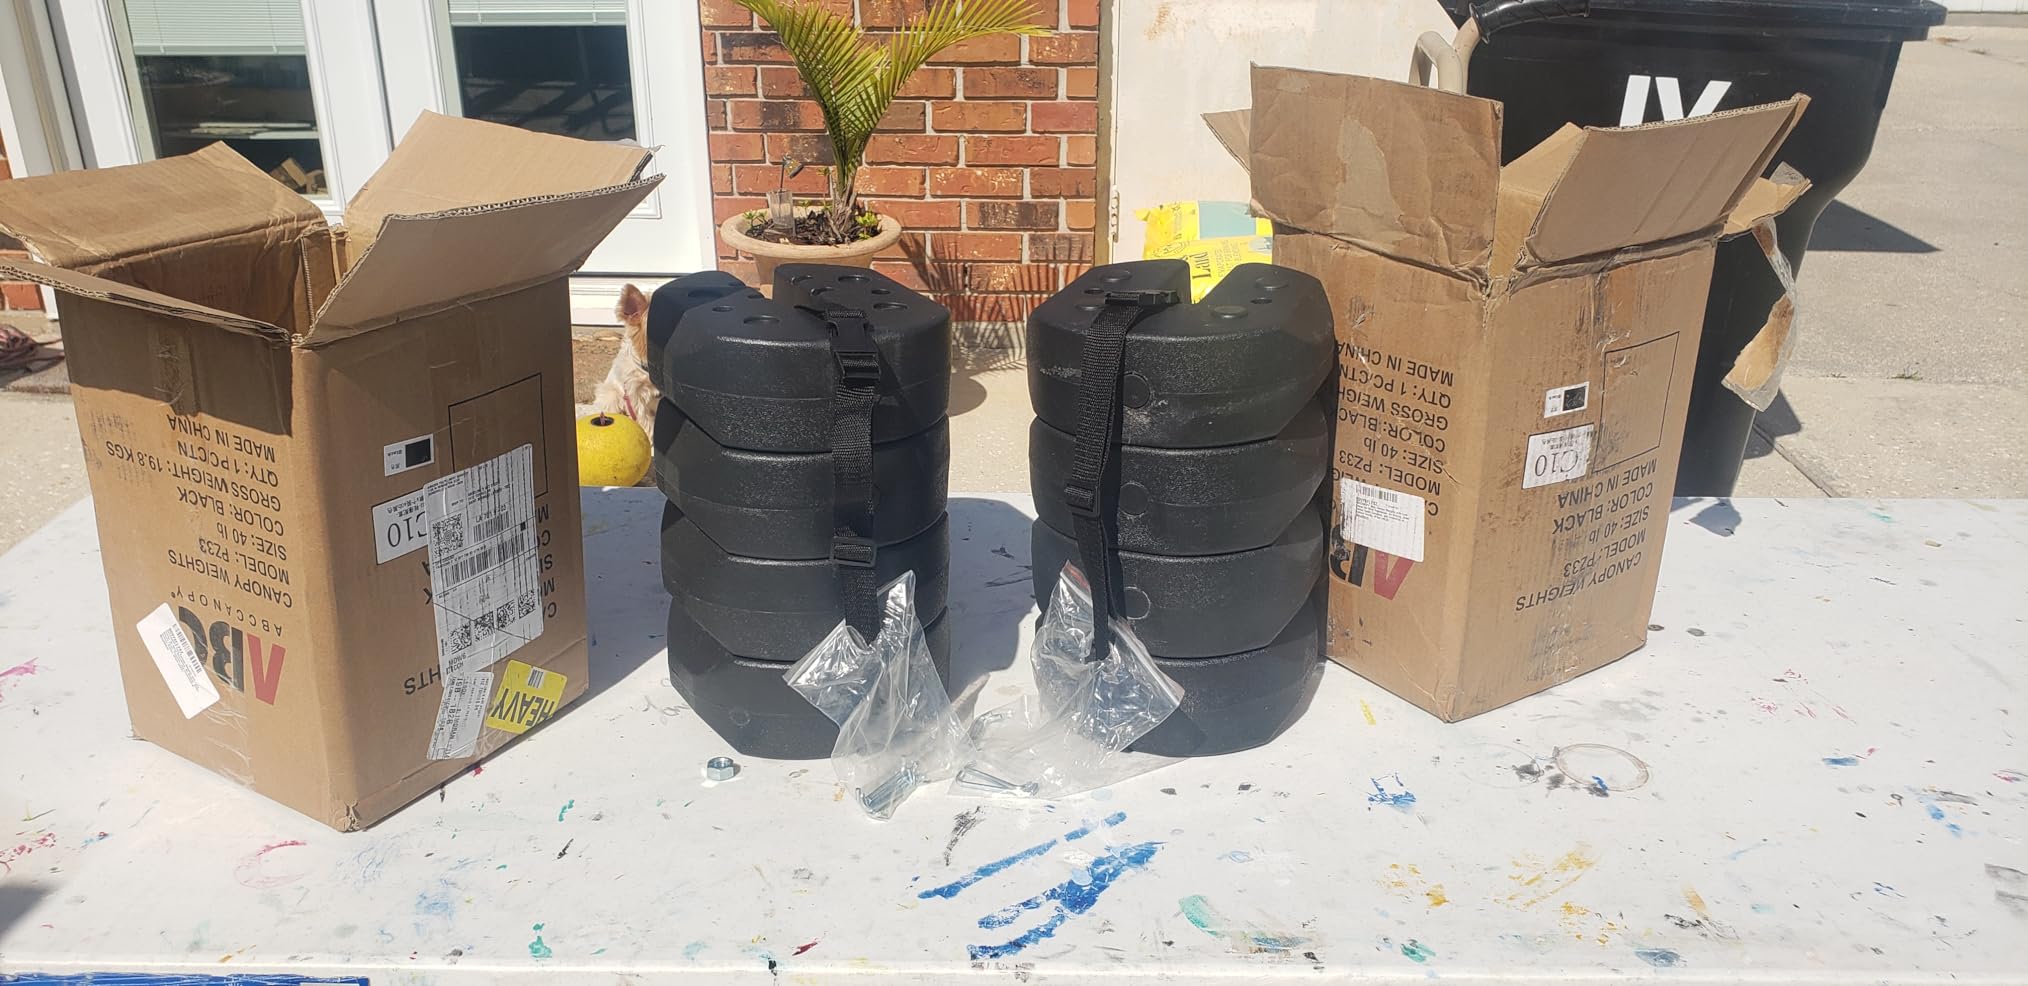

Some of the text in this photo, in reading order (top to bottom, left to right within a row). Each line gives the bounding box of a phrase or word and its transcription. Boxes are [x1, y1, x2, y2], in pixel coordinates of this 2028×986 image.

[1387, 355, 1401, 372] IN
[1406, 360, 1454, 387] MADE
[1400, 382, 1407, 396] 1
[1413, 385, 1451, 409] QTY:
[1338, 387, 1448, 431] GROSS WEIGH
[166, 414, 275, 463] MADE IN CHINA
[1339, 408, 1446, 453] COLOR: BLAC
[234, 458, 240, 474] 1
[245, 462, 279, 488] QTY:
[1340, 450, 1372, 473] PZ33
[1364, 437, 1444, 474] SIZE: 40 lb
[1535, 450, 1579, 476] C10
[105, 440, 281, 512] GROSS WEIGHT: 19.8 KGS
[1379, 463, 1440, 496] MODEL:
[1558, 458, 1657, 509] MADE IN CHINA
[177, 486, 284, 537] COLOR: BLACK
[1552, 482, 1653, 535] COLOR: BLACK
[1589, 505, 1650, 544] SIZE: 40 lb
[199, 537, 290, 585] MODEL: PZ33
[217, 522, 287, 561] SIZE: 40 lb
[1563, 528, 1646, 577] MODEL: PZ33
[168, 549, 292, 608] CANOPY WEIGHTS
[1516, 551, 1642, 611] CANOPY WEIGHTS
[491, 688, 555, 727] HEAVY
